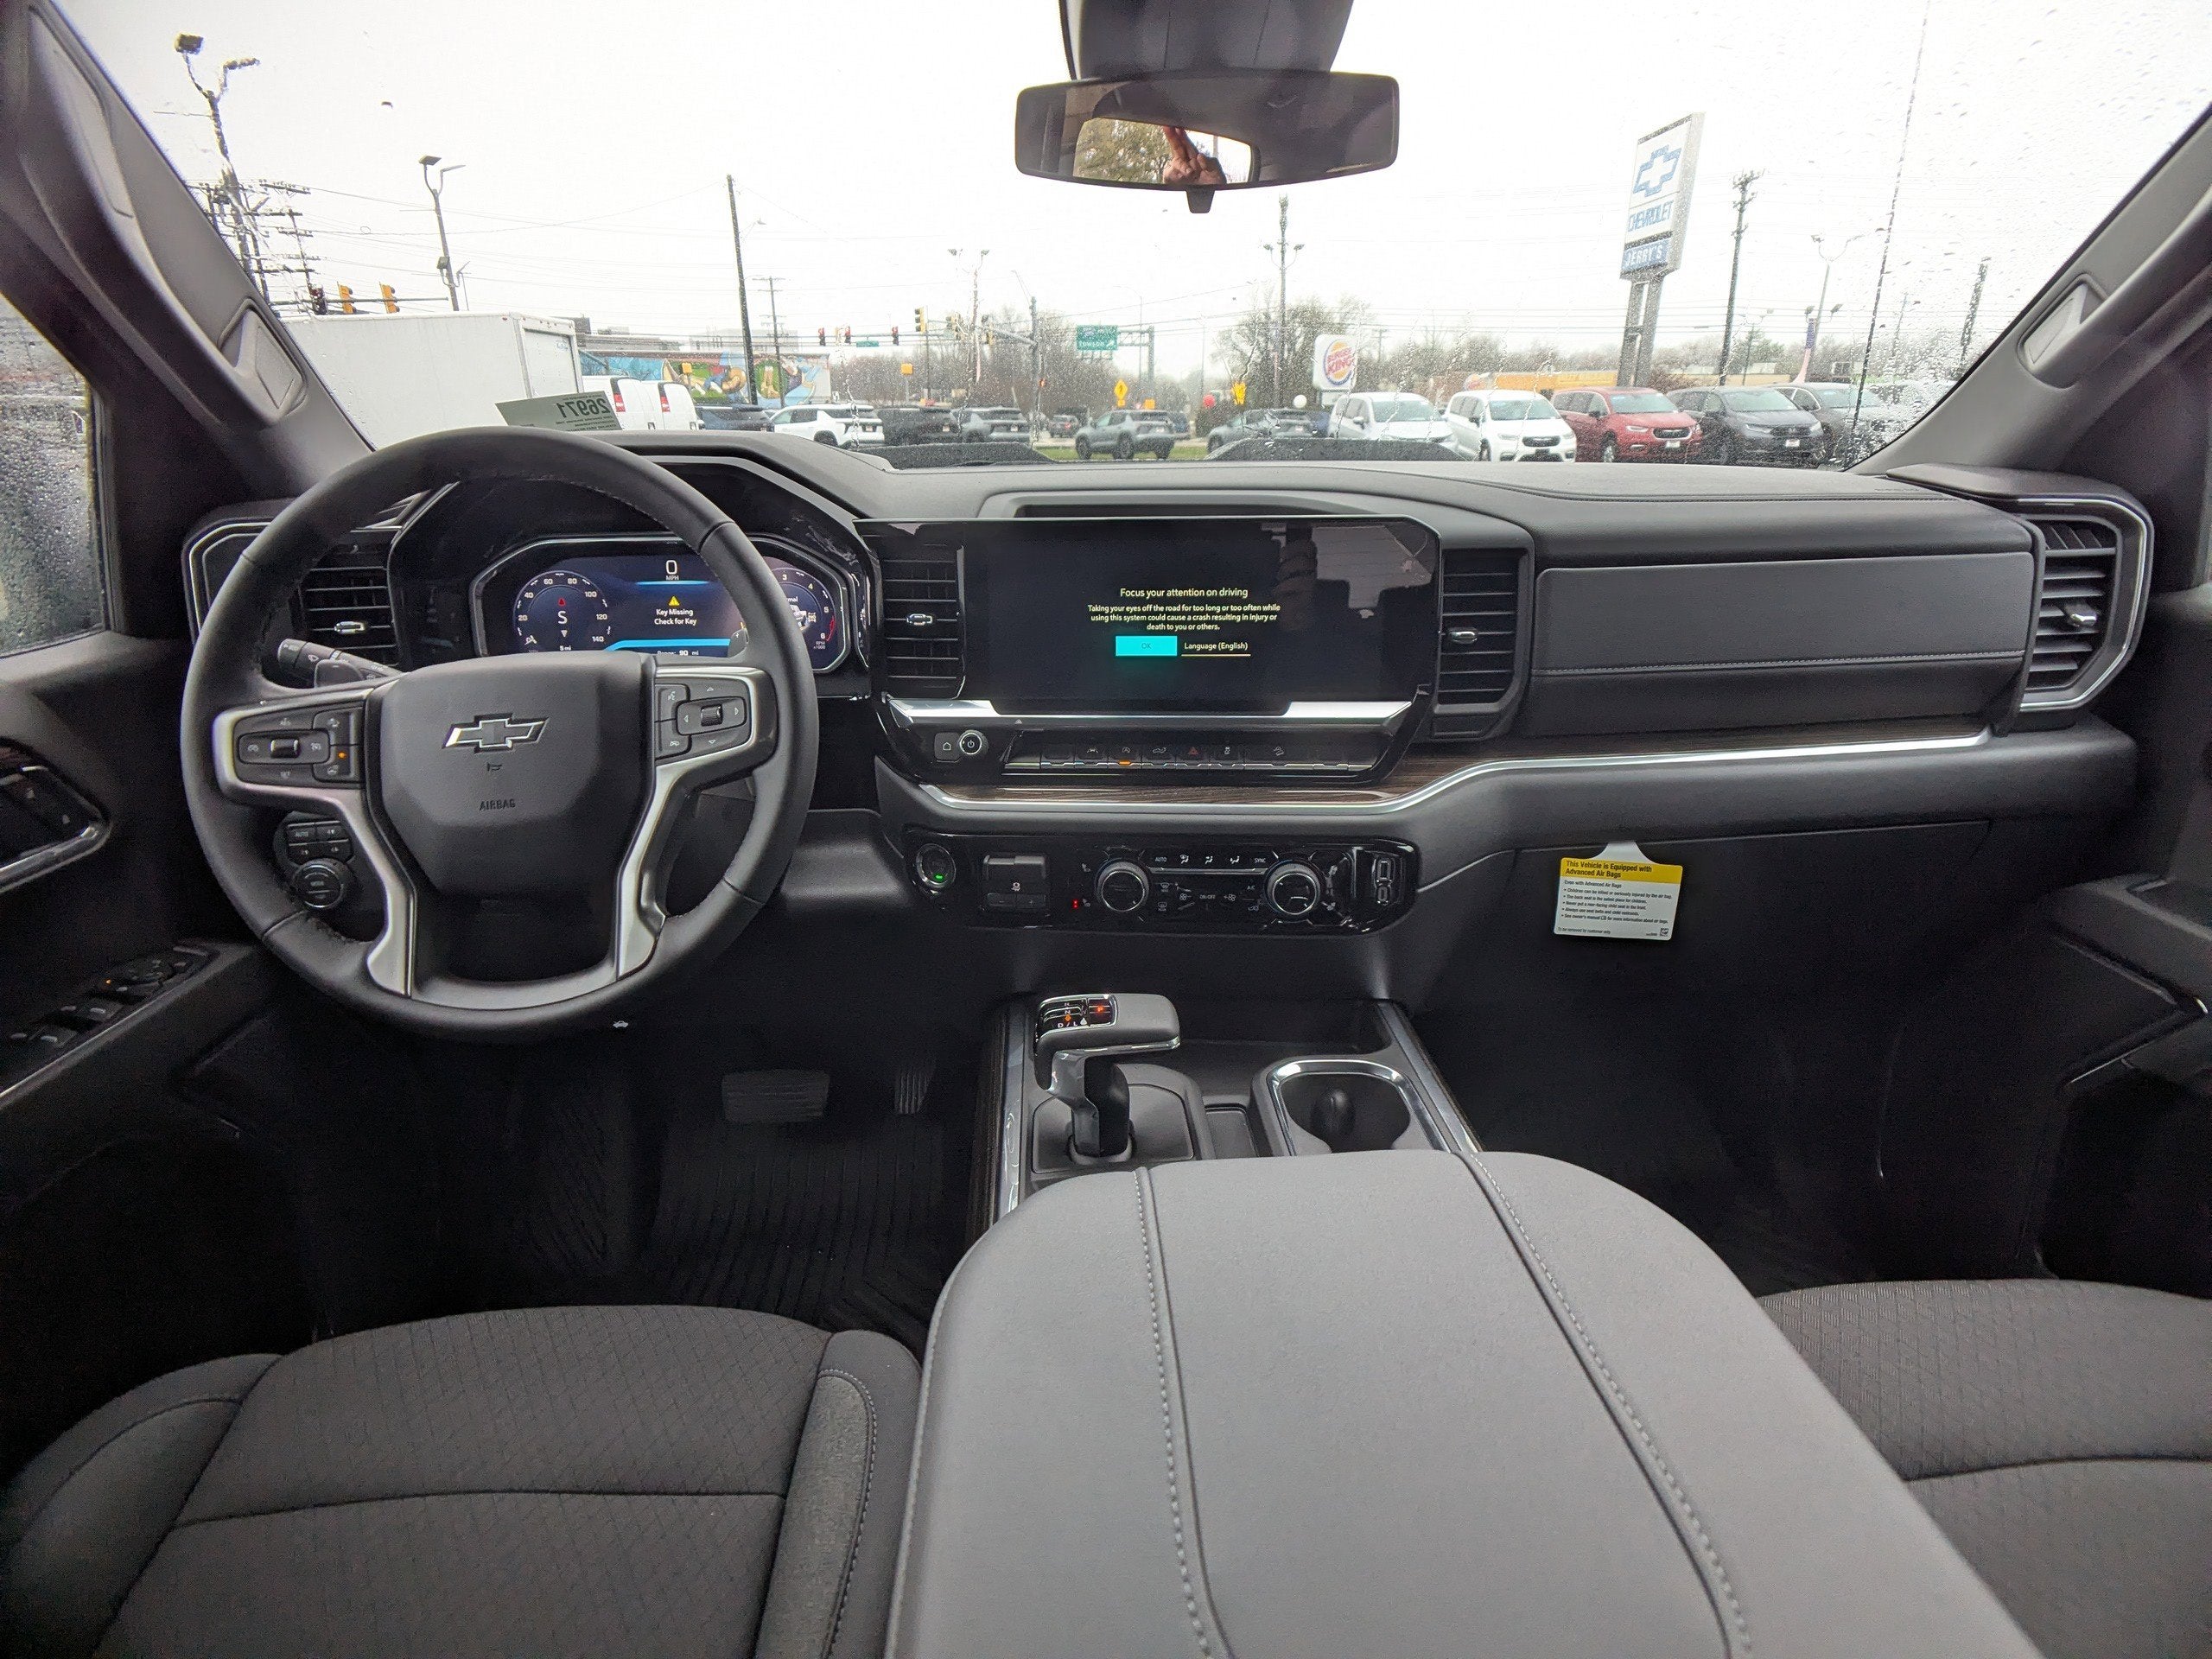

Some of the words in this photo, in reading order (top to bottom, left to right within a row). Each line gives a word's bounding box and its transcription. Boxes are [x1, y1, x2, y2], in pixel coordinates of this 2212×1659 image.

[1628, 200, 1675, 232] CHEVROLET
[1624, 243, 1663, 267] JERRY'S
[665, 560, 677, 575] 0
[1120, 588, 1145, 597] Focus
[1147, 589, 1165, 599] your
[1166, 588, 1205, 597] attention
[1219, 588, 1248, 598] driving
[557, 611, 568, 624] S
[683, 618, 696, 626] Key
[1211, 613, 1241, 622] resulting
[1249, 613, 1268, 622] injury
[1184, 642, 1217, 651] Language
[1218, 642, 1248, 651] (English)
[479, 798, 516, 811] AIRBAG
